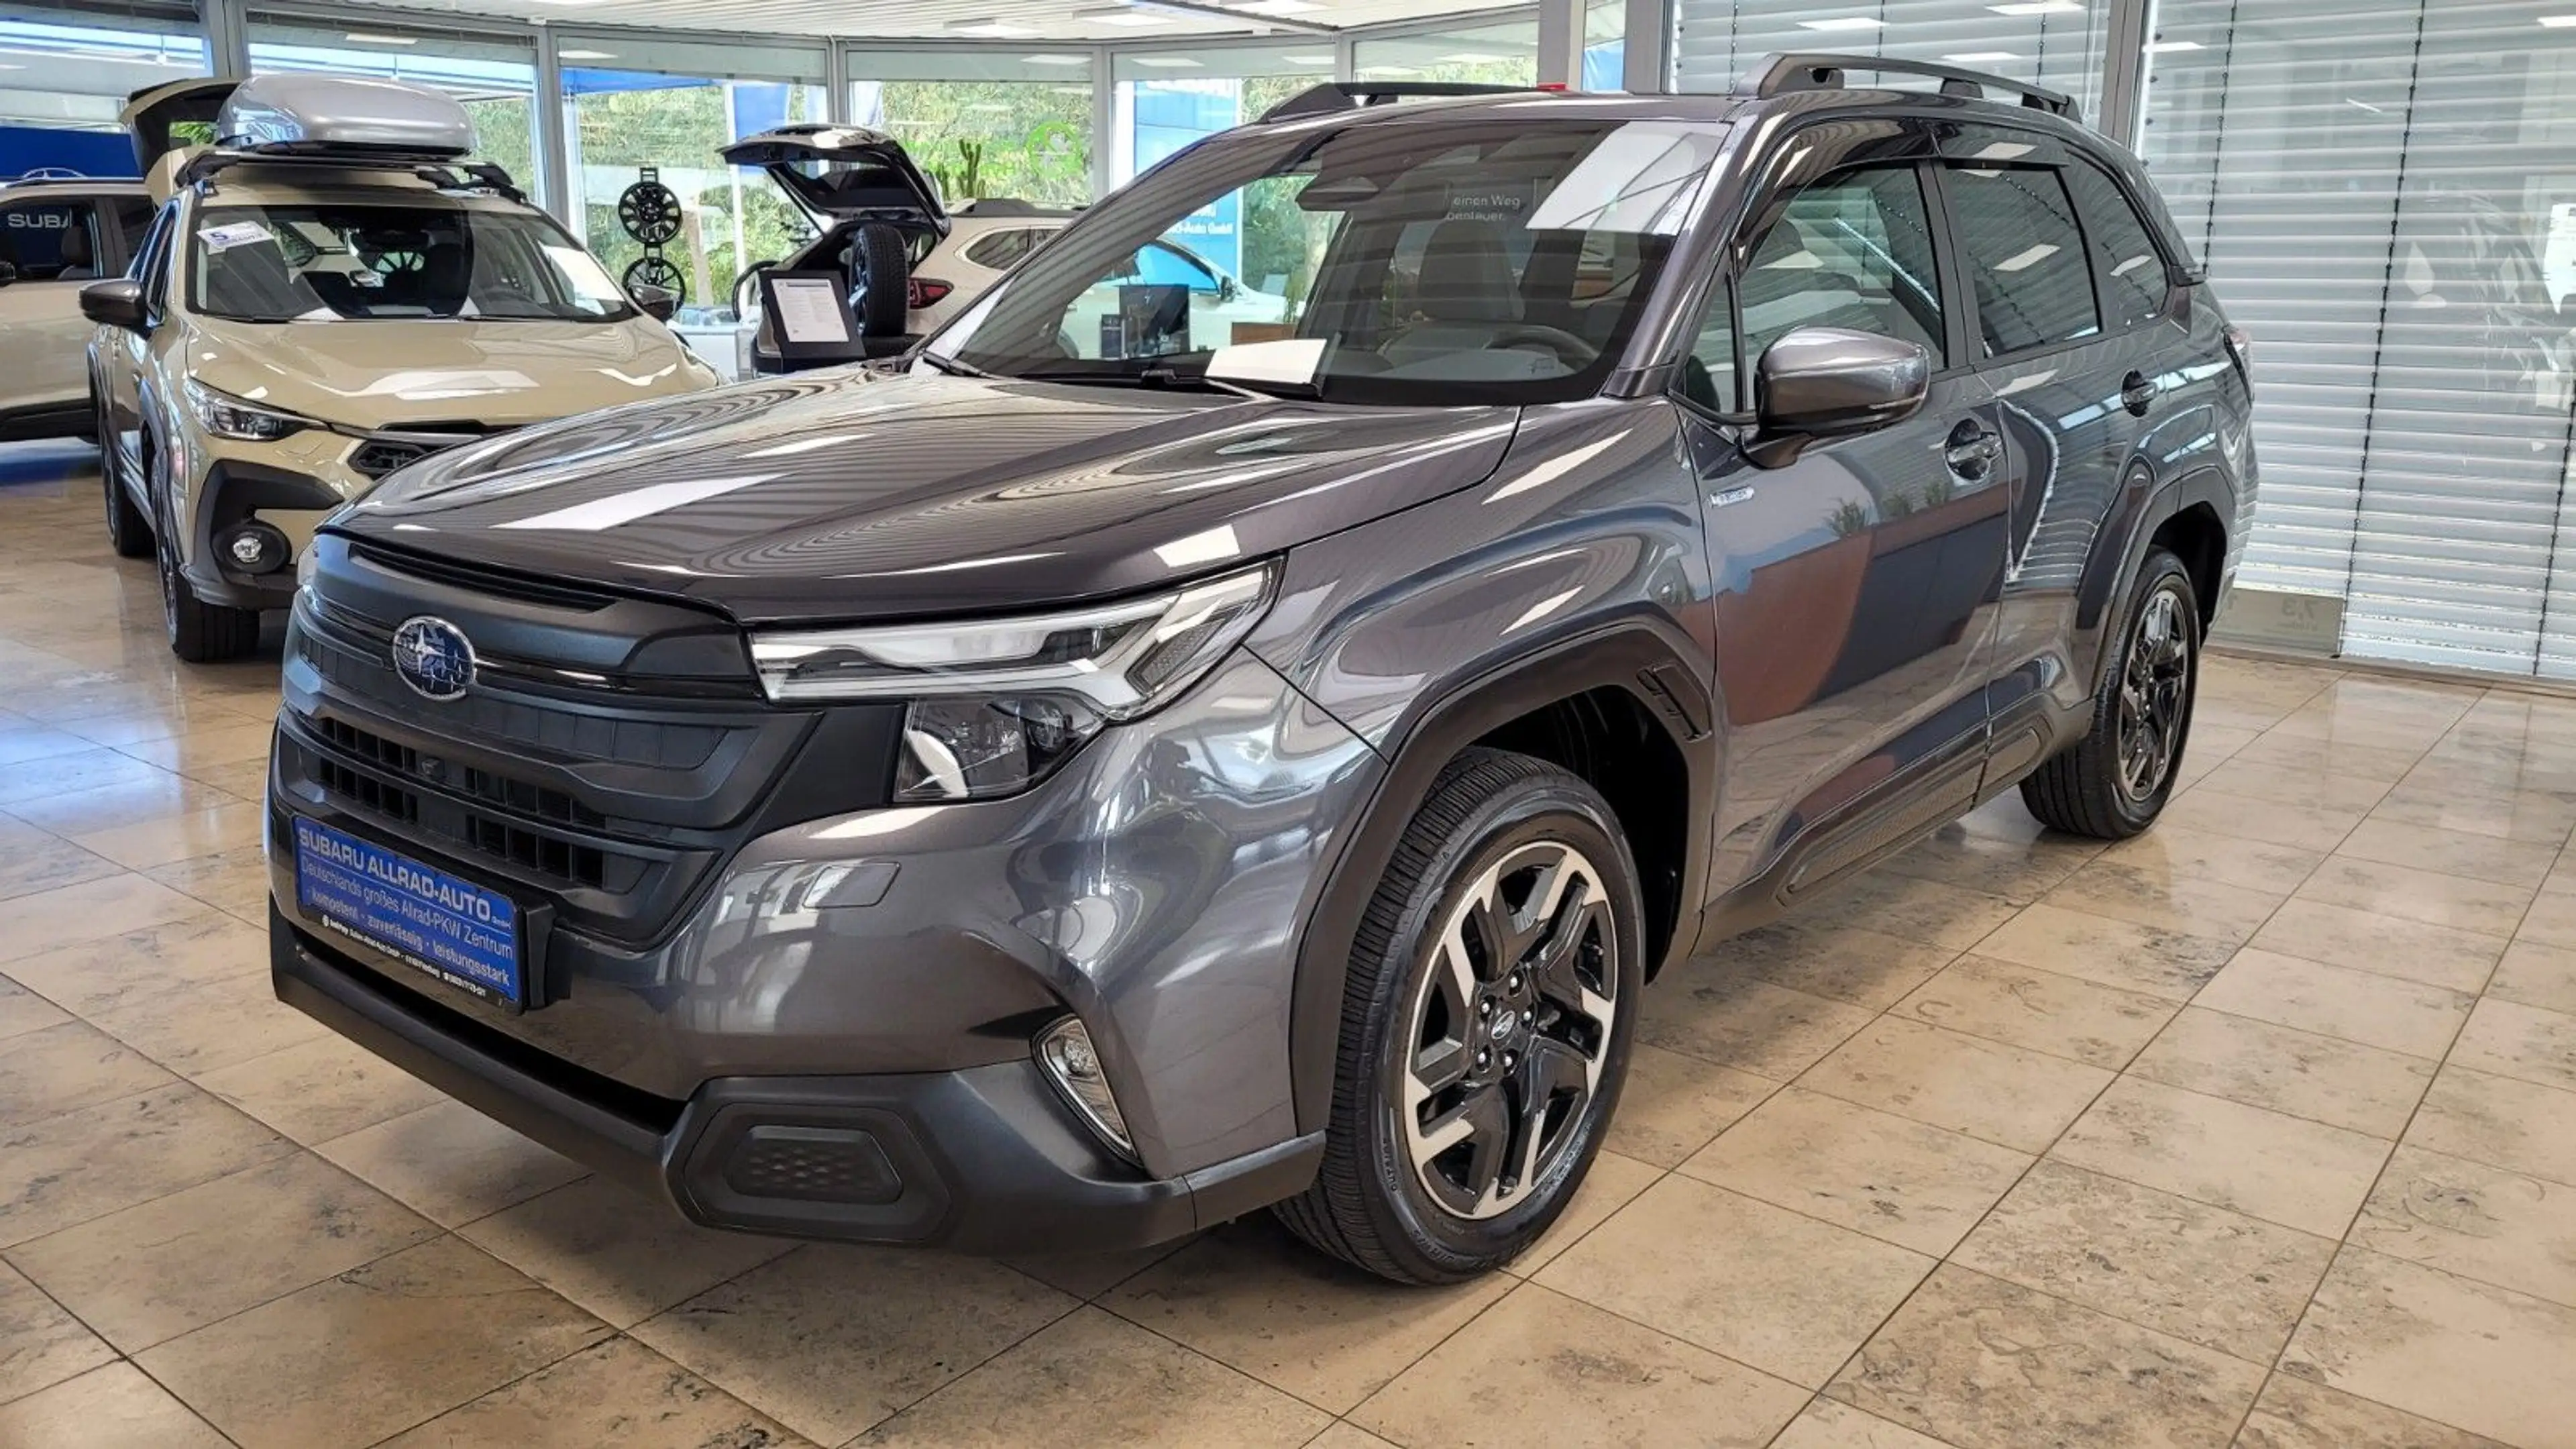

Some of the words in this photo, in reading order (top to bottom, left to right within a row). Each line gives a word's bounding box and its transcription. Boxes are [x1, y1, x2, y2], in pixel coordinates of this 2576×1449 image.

[1491, 193, 1521, 211] Weg
[299, 827, 365, 871] SUBARU
[368, 855, 490, 922] ALLRAD-AUTO
[301, 855, 362, 898] Deutschlands
[363, 886, 400, 912] großes
[402, 900, 461, 939] Allrad-PKW
[463, 924, 513, 961] Zentrum
[311, 886, 359, 920] kompetent
[433, 940, 510, 986] leistungsstark
